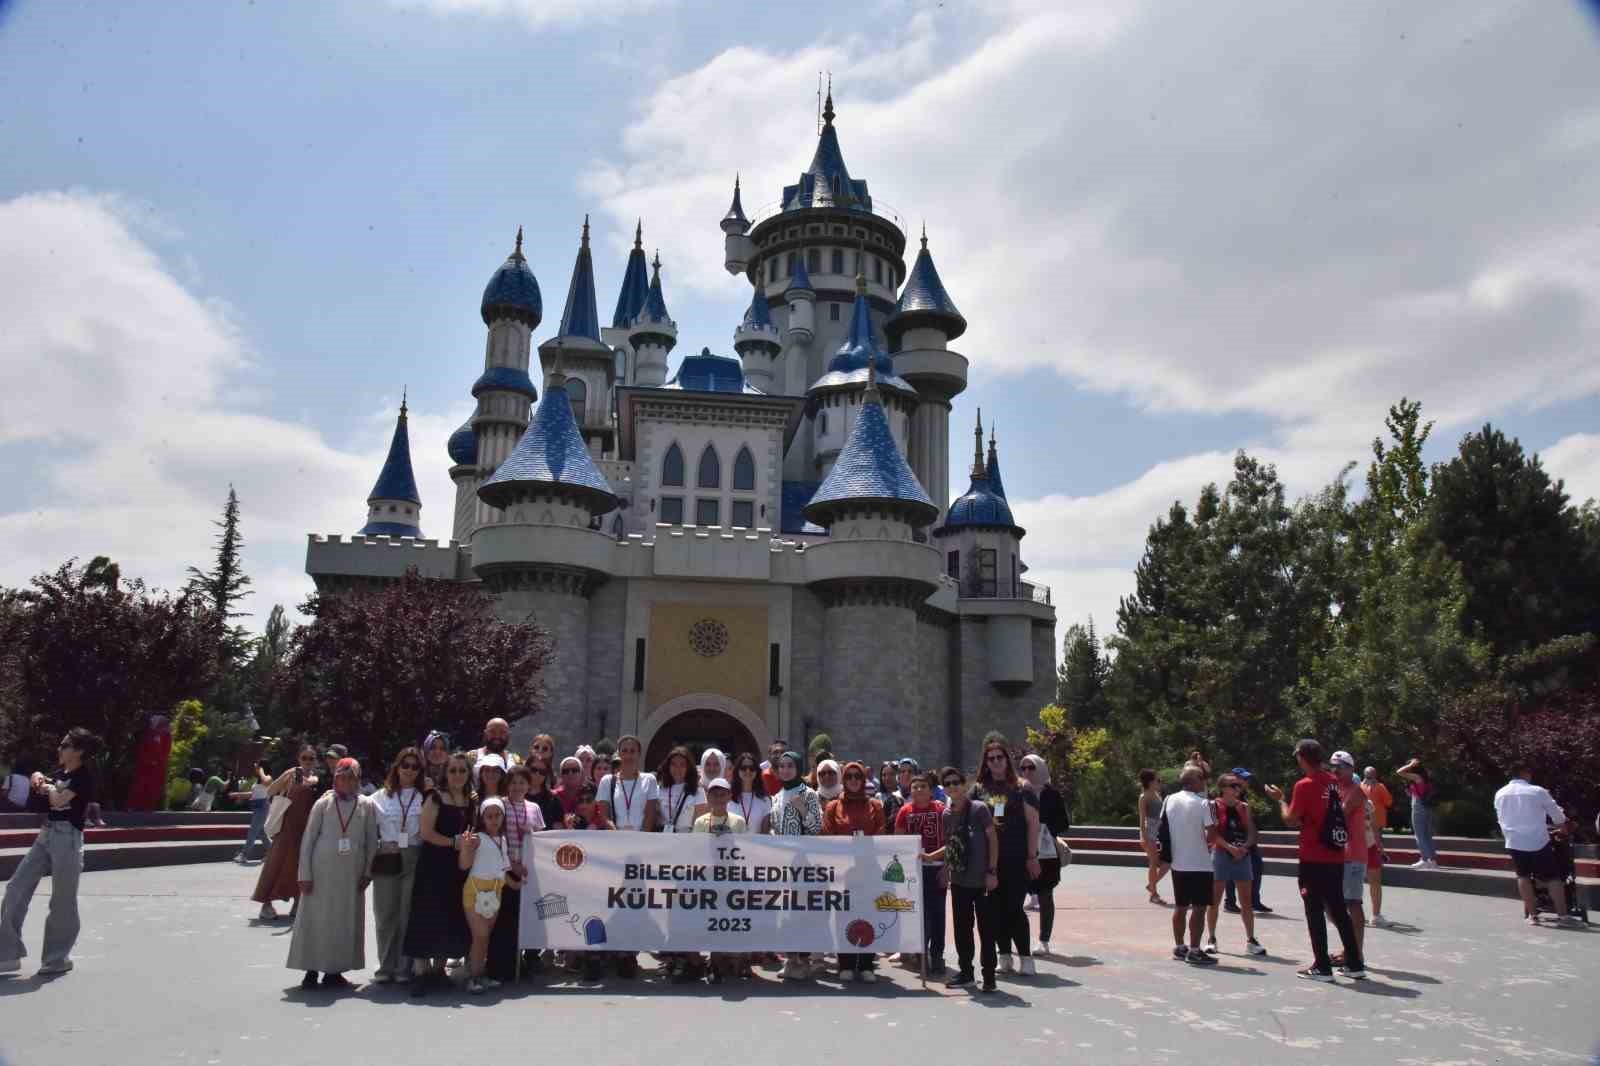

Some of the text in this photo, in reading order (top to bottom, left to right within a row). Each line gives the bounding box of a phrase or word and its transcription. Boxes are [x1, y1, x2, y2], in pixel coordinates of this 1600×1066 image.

[717, 847, 745, 860] T.C.
[607, 887, 718, 910] KÜLTÜR
[708, 917, 751, 932] 2023
